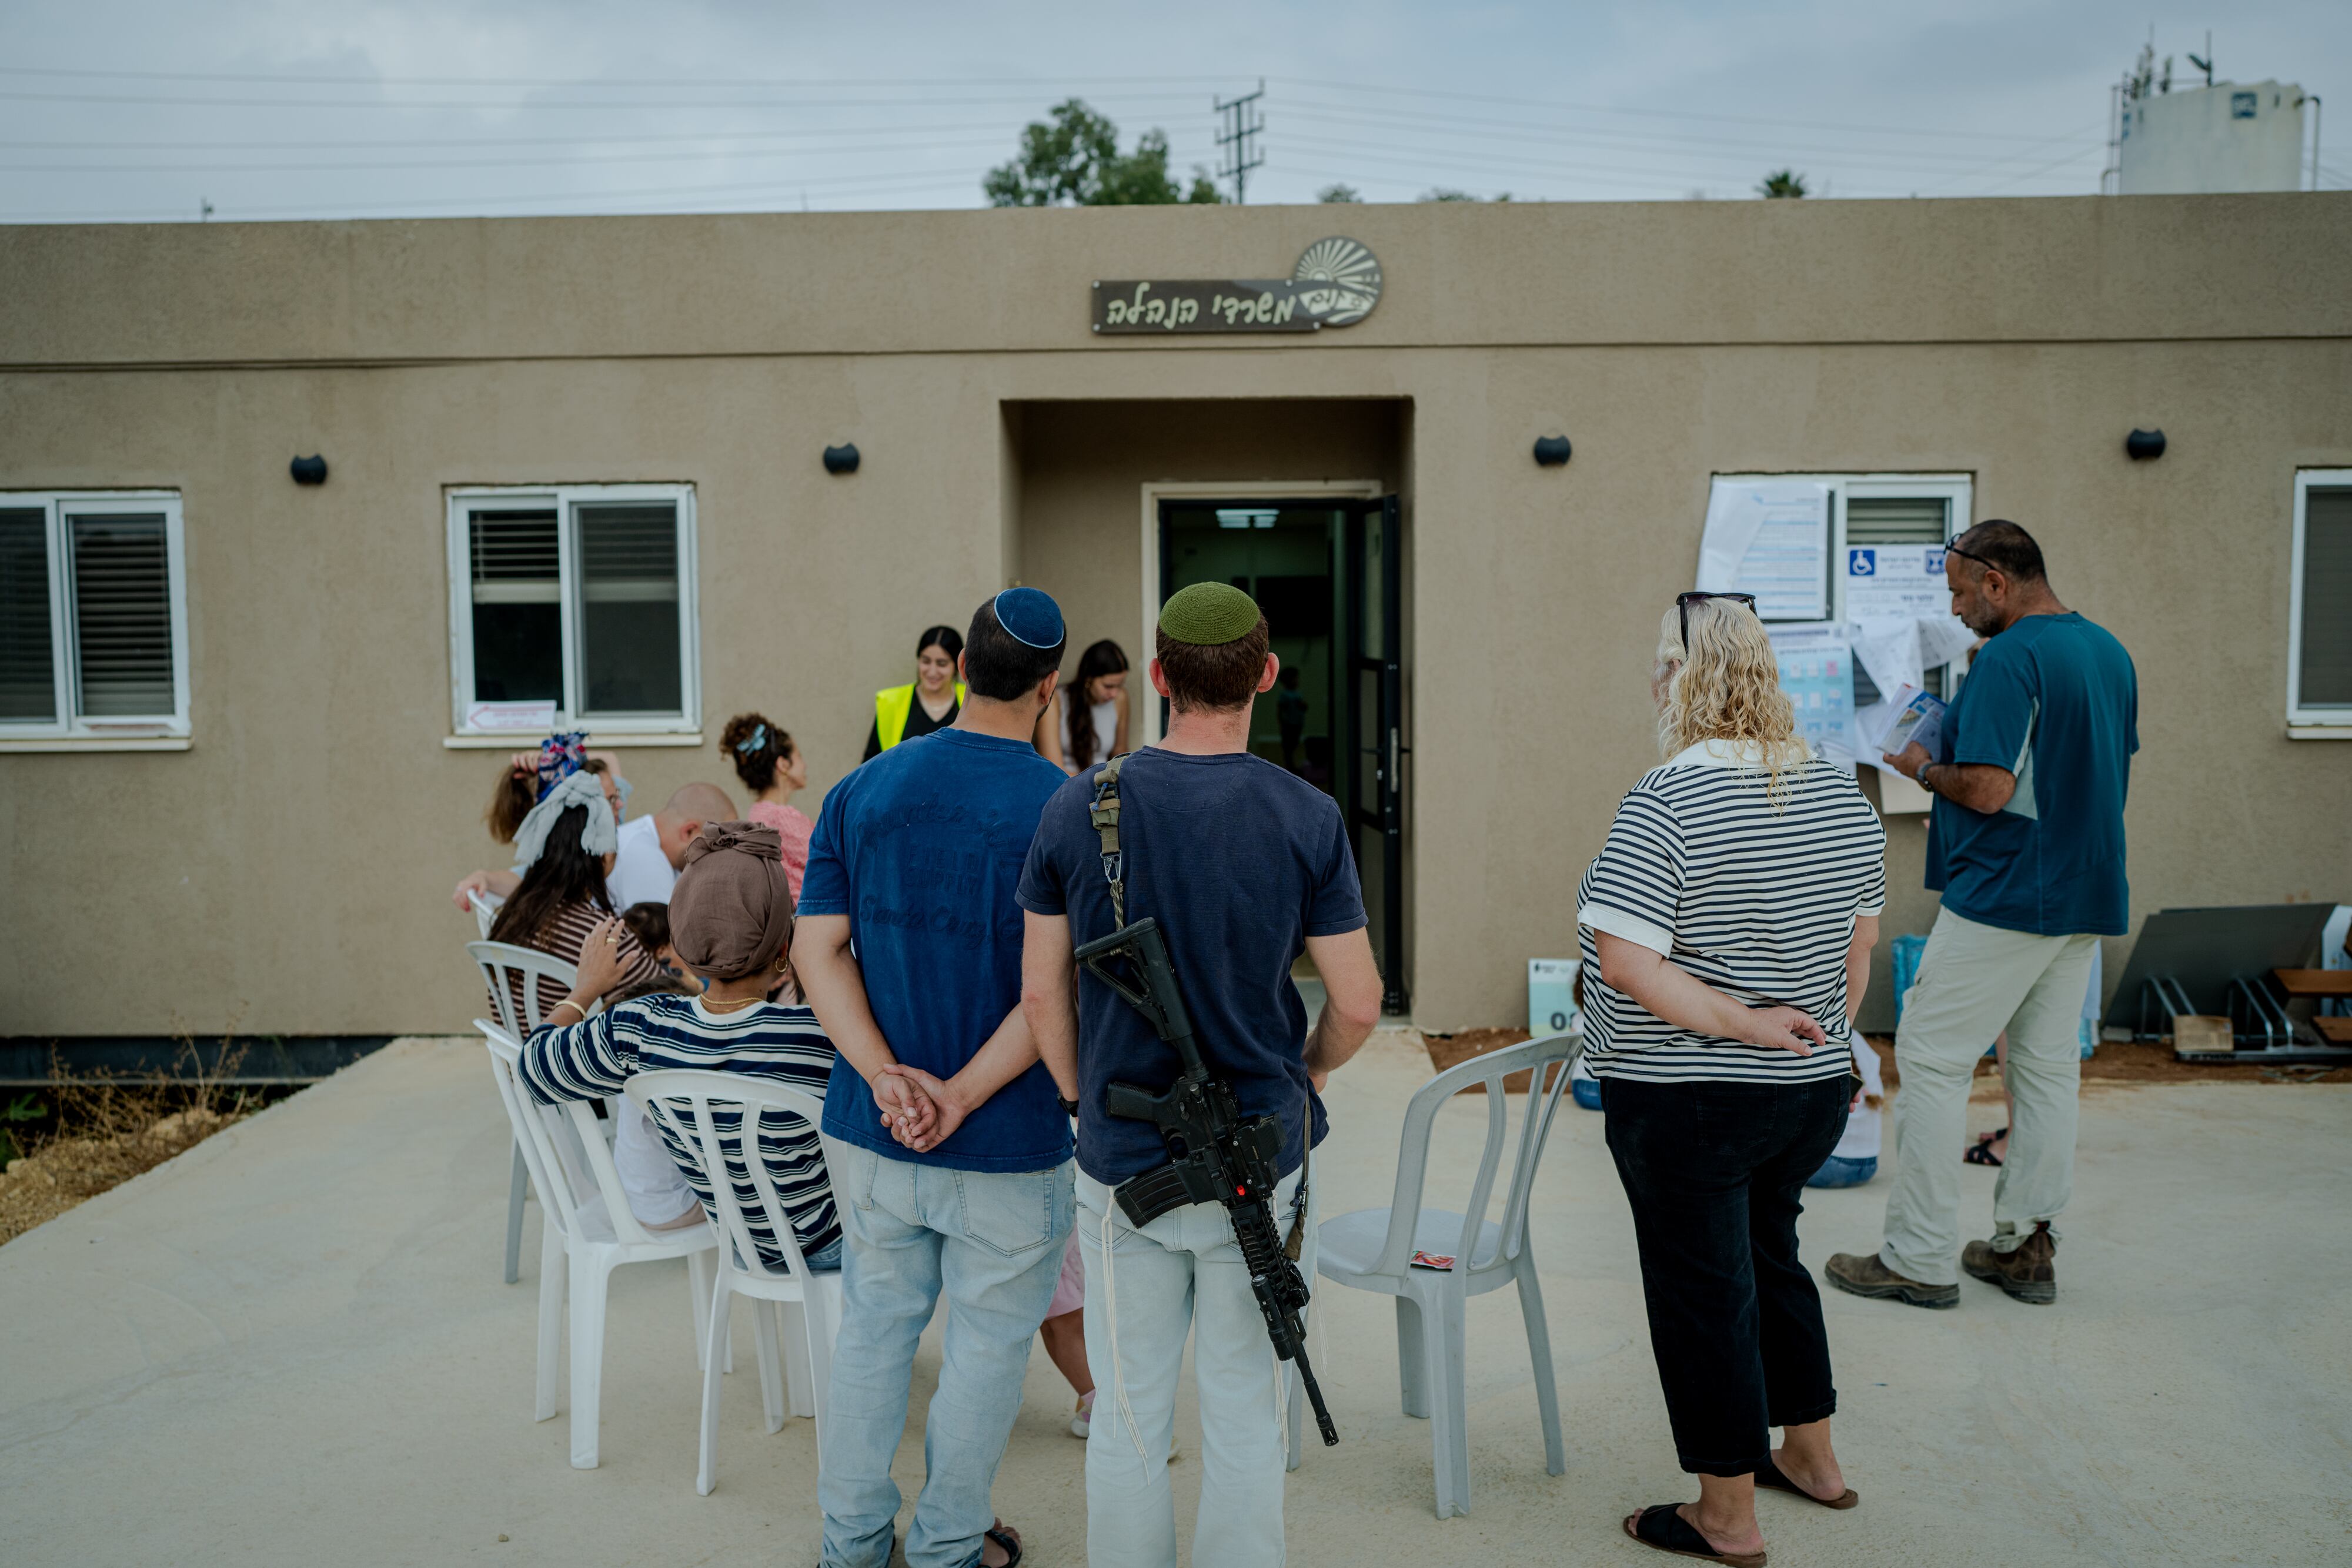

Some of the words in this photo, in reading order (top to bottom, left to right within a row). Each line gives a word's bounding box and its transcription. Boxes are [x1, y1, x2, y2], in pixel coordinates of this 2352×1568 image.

[1107, 282, 1199, 330] הנהלה
[1212, 292, 1297, 325] משרדי
[907, 845, 979, 874] FIELD
[903, 866, 979, 895] SUPPLY
[860, 894, 925, 930] Santa
